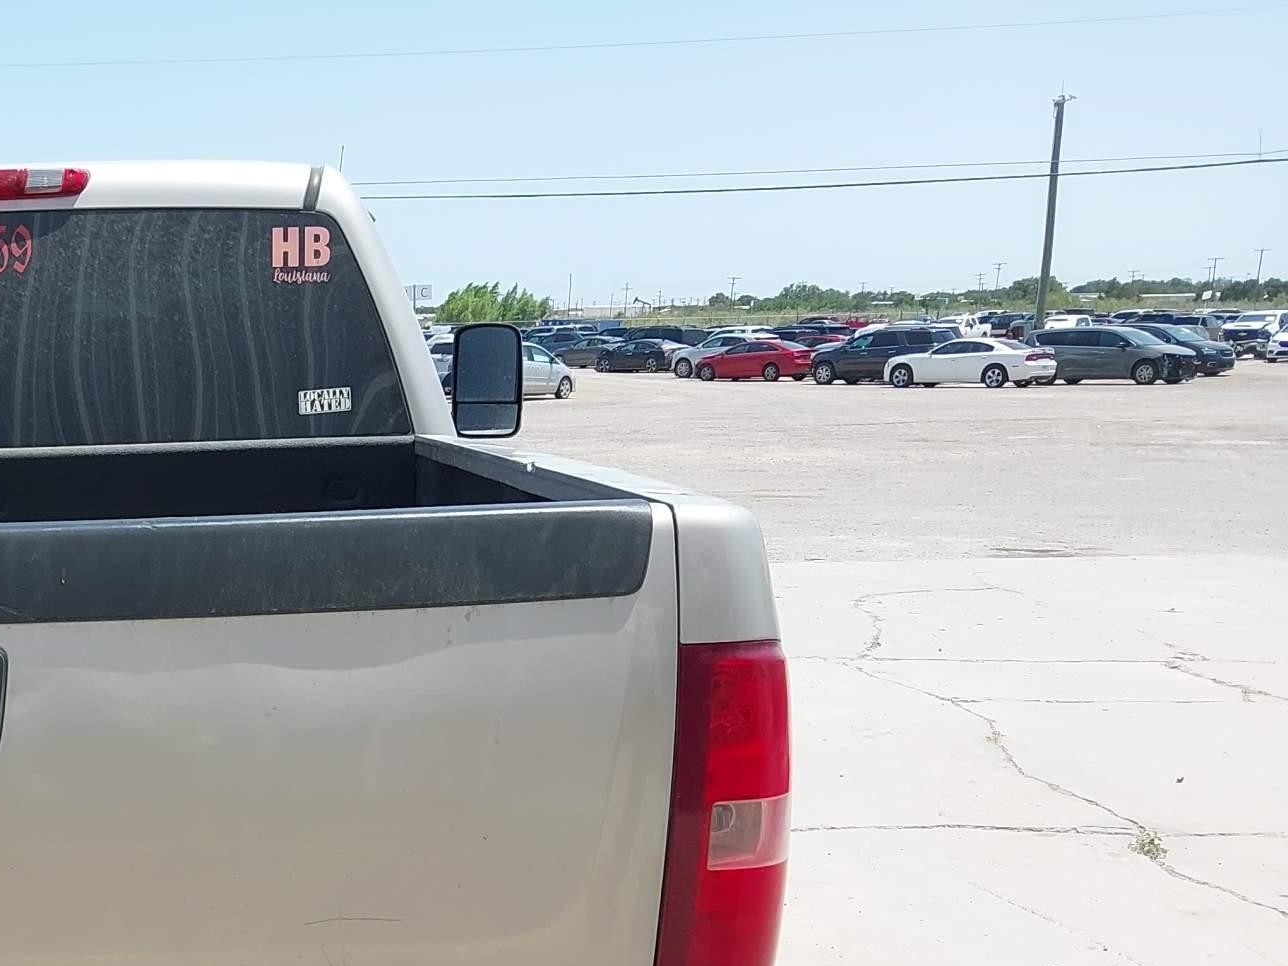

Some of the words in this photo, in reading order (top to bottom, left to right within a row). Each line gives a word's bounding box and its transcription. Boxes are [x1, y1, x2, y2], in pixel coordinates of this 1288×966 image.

[272, 226, 330, 268] HB
[273, 268, 330, 284] Louisiana
[420, 287, 429, 298] C
